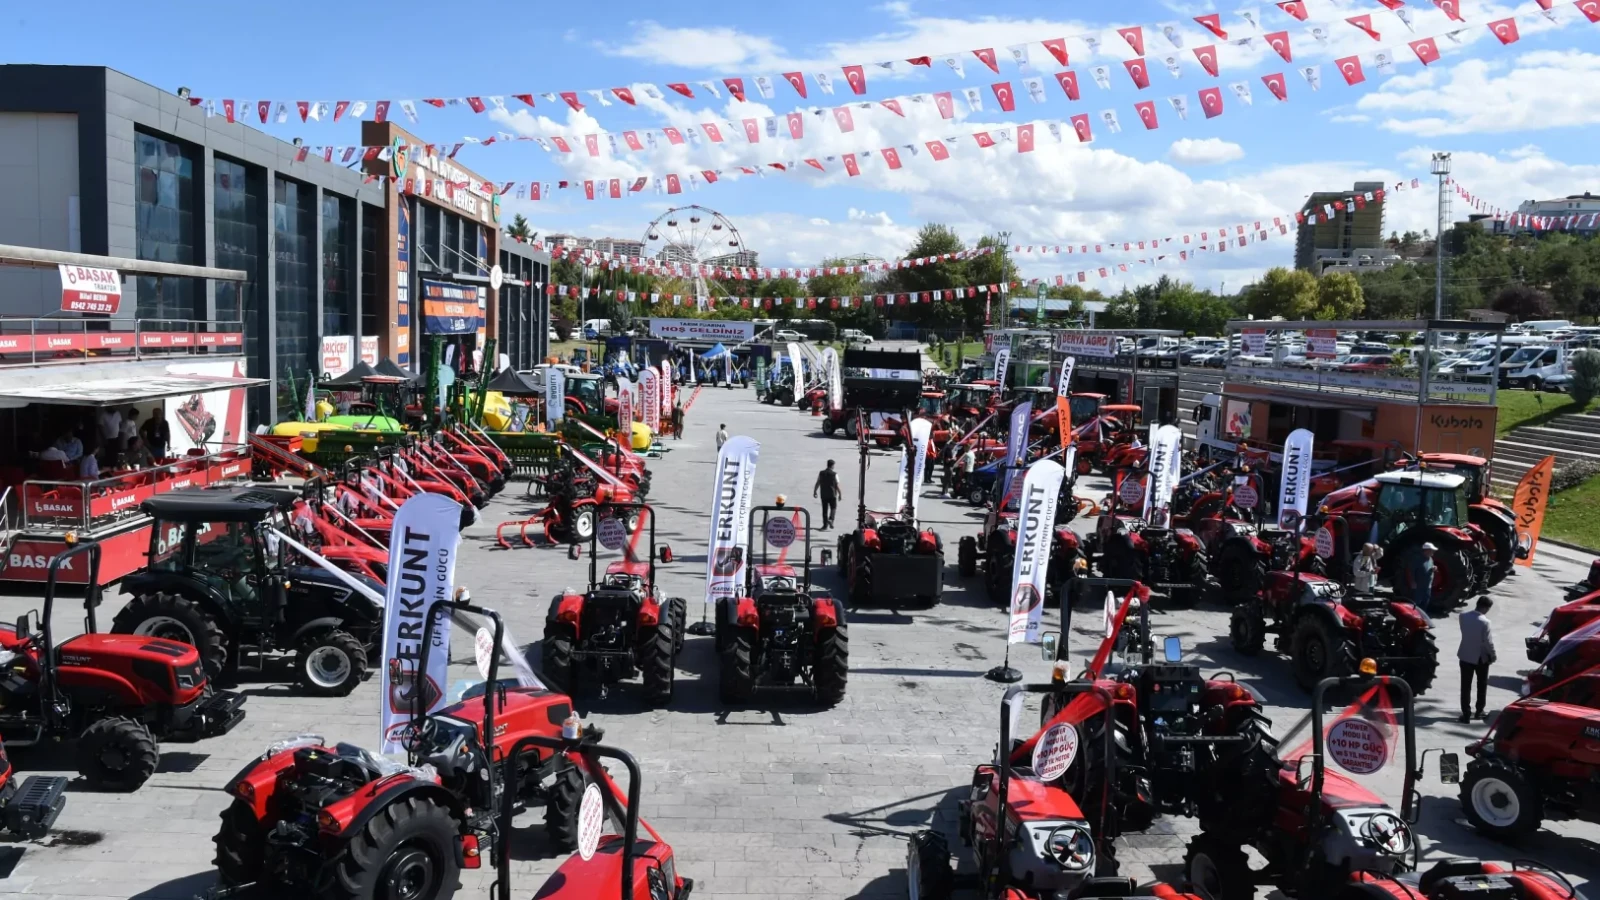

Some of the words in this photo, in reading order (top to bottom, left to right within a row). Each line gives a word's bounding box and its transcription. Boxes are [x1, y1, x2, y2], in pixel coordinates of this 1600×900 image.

[70, 301, 86, 309] 0542
[690, 327, 744, 335] GELDİNİZ
[1062, 334, 1084, 345] DERYA
[1086, 336, 1107, 346] AGRO
[322, 342, 347, 356] ARIÇİÇEK
[1431, 414, 1483, 429] Kubota
[1284, 445, 1301, 505] ERKUNT
[116, 495, 135, 506] BASAK
[717, 457, 740, 541] ERKUNT
[1519, 471, 1543, 528] Kubota
[43, 504, 73, 512] BASAK
[1021, 484, 1045, 576] ERKUNT
[10, 554, 73, 570] BASAK
[436, 548, 449, 582] GÜCÜ
[396, 526, 430, 660] ERKUNT
[432, 586, 445, 647] ÇİFTÇİİN
[1345, 722, 1368, 731] POWER
[1049, 747, 1058, 755] HP
[1059, 741, 1074, 752] GÜÇ
[1332, 739, 1347, 747] +10
[1348, 740, 1360, 749] HP
[1362, 742, 1383, 755] GÜÇ
